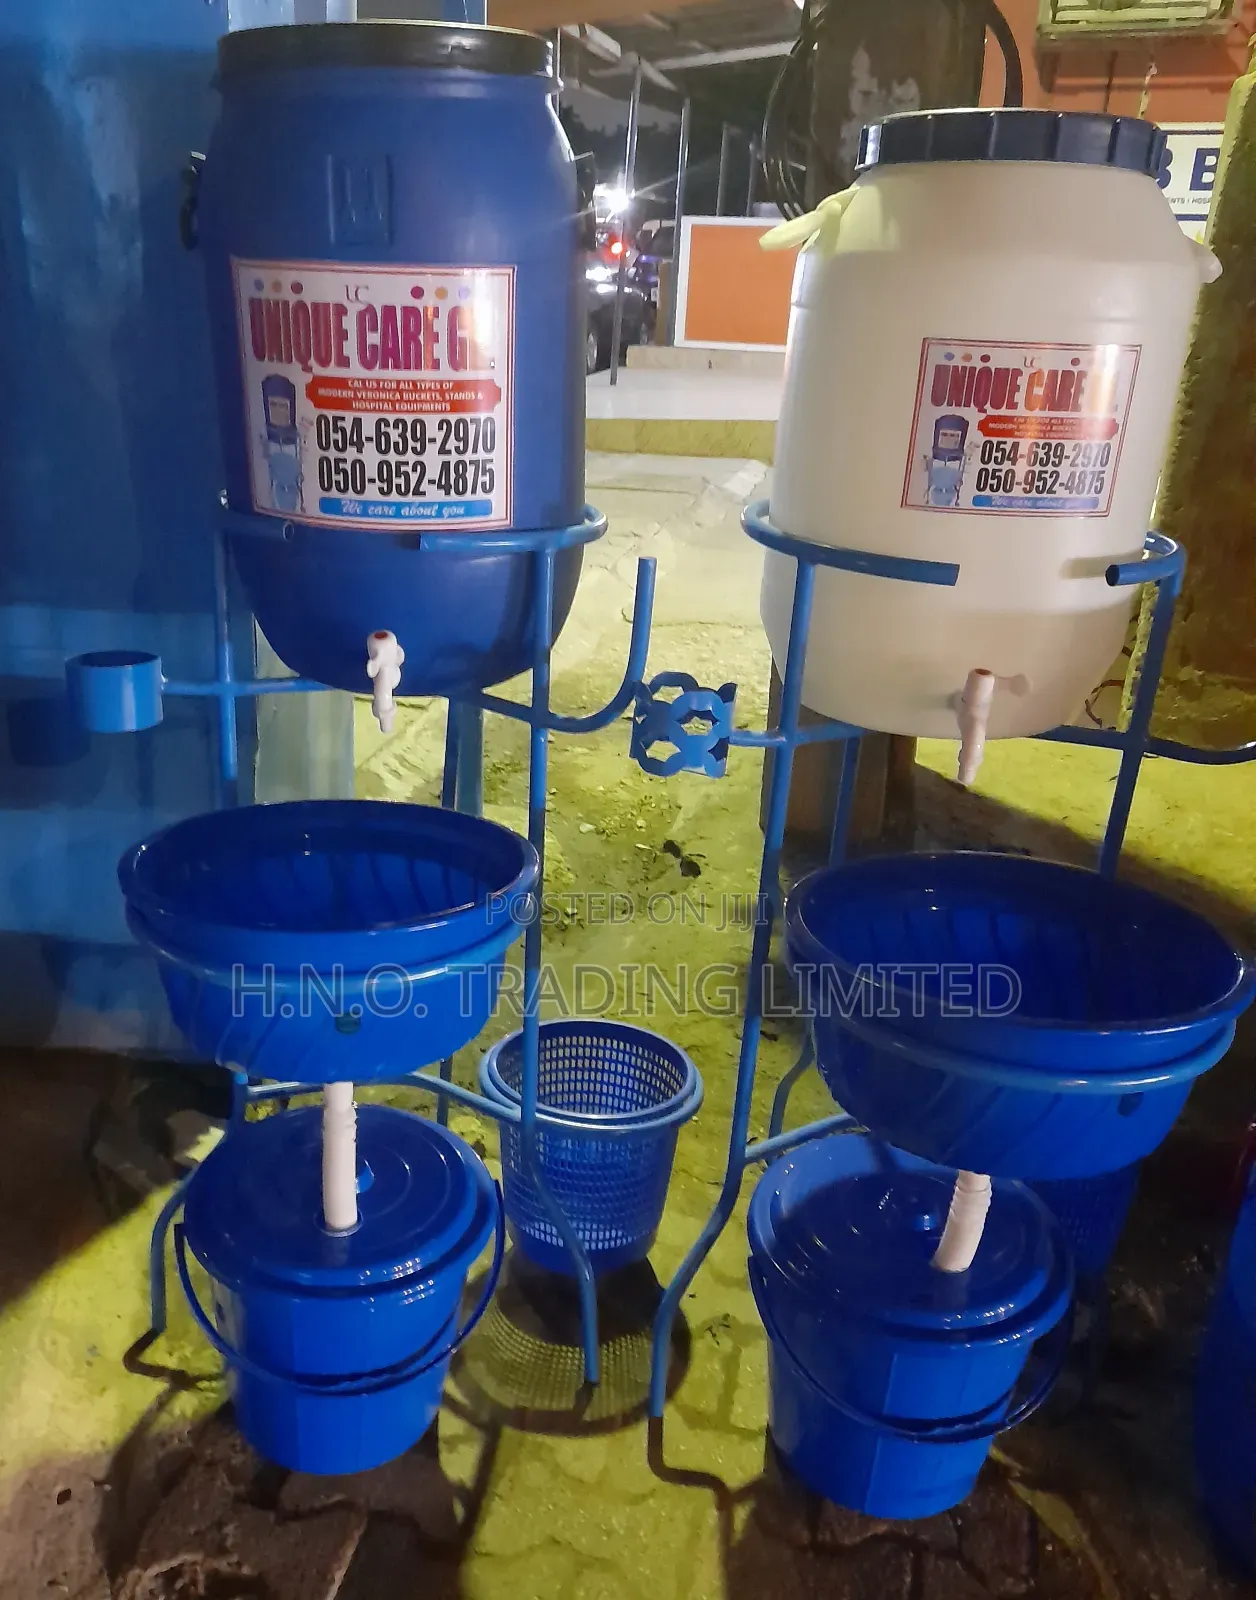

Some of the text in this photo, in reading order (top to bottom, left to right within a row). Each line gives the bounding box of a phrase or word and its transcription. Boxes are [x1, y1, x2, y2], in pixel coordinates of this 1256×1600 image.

[249, 298, 351, 374] UNIQUE
[356, 303, 441, 372] CARE
[318, 387, 354, 398] MODERN
[357, 390, 401, 400] VERONICA
[445, 391, 476, 400] STANDS
[365, 379, 378, 389] US
[379, 380, 397, 390] FOR
[400, 380, 413, 390] ALL
[416, 381, 441, 390] TYPES
[442, 381, 454, 390] OF
[930, 363, 1024, 414] UNIQUE
[1024, 368, 1088, 413] CARE
[352, 400, 451, 412] HOSPITAL EQUIPMENTS
[316, 413, 496, 455] 054-639-2970
[979, 439, 1112, 468] 054-639-2970
[317, 455, 495, 497] 050-952-4875
[975, 467, 1106, 496] 050-952-4875
[341, 499, 465, 515] We care about you
